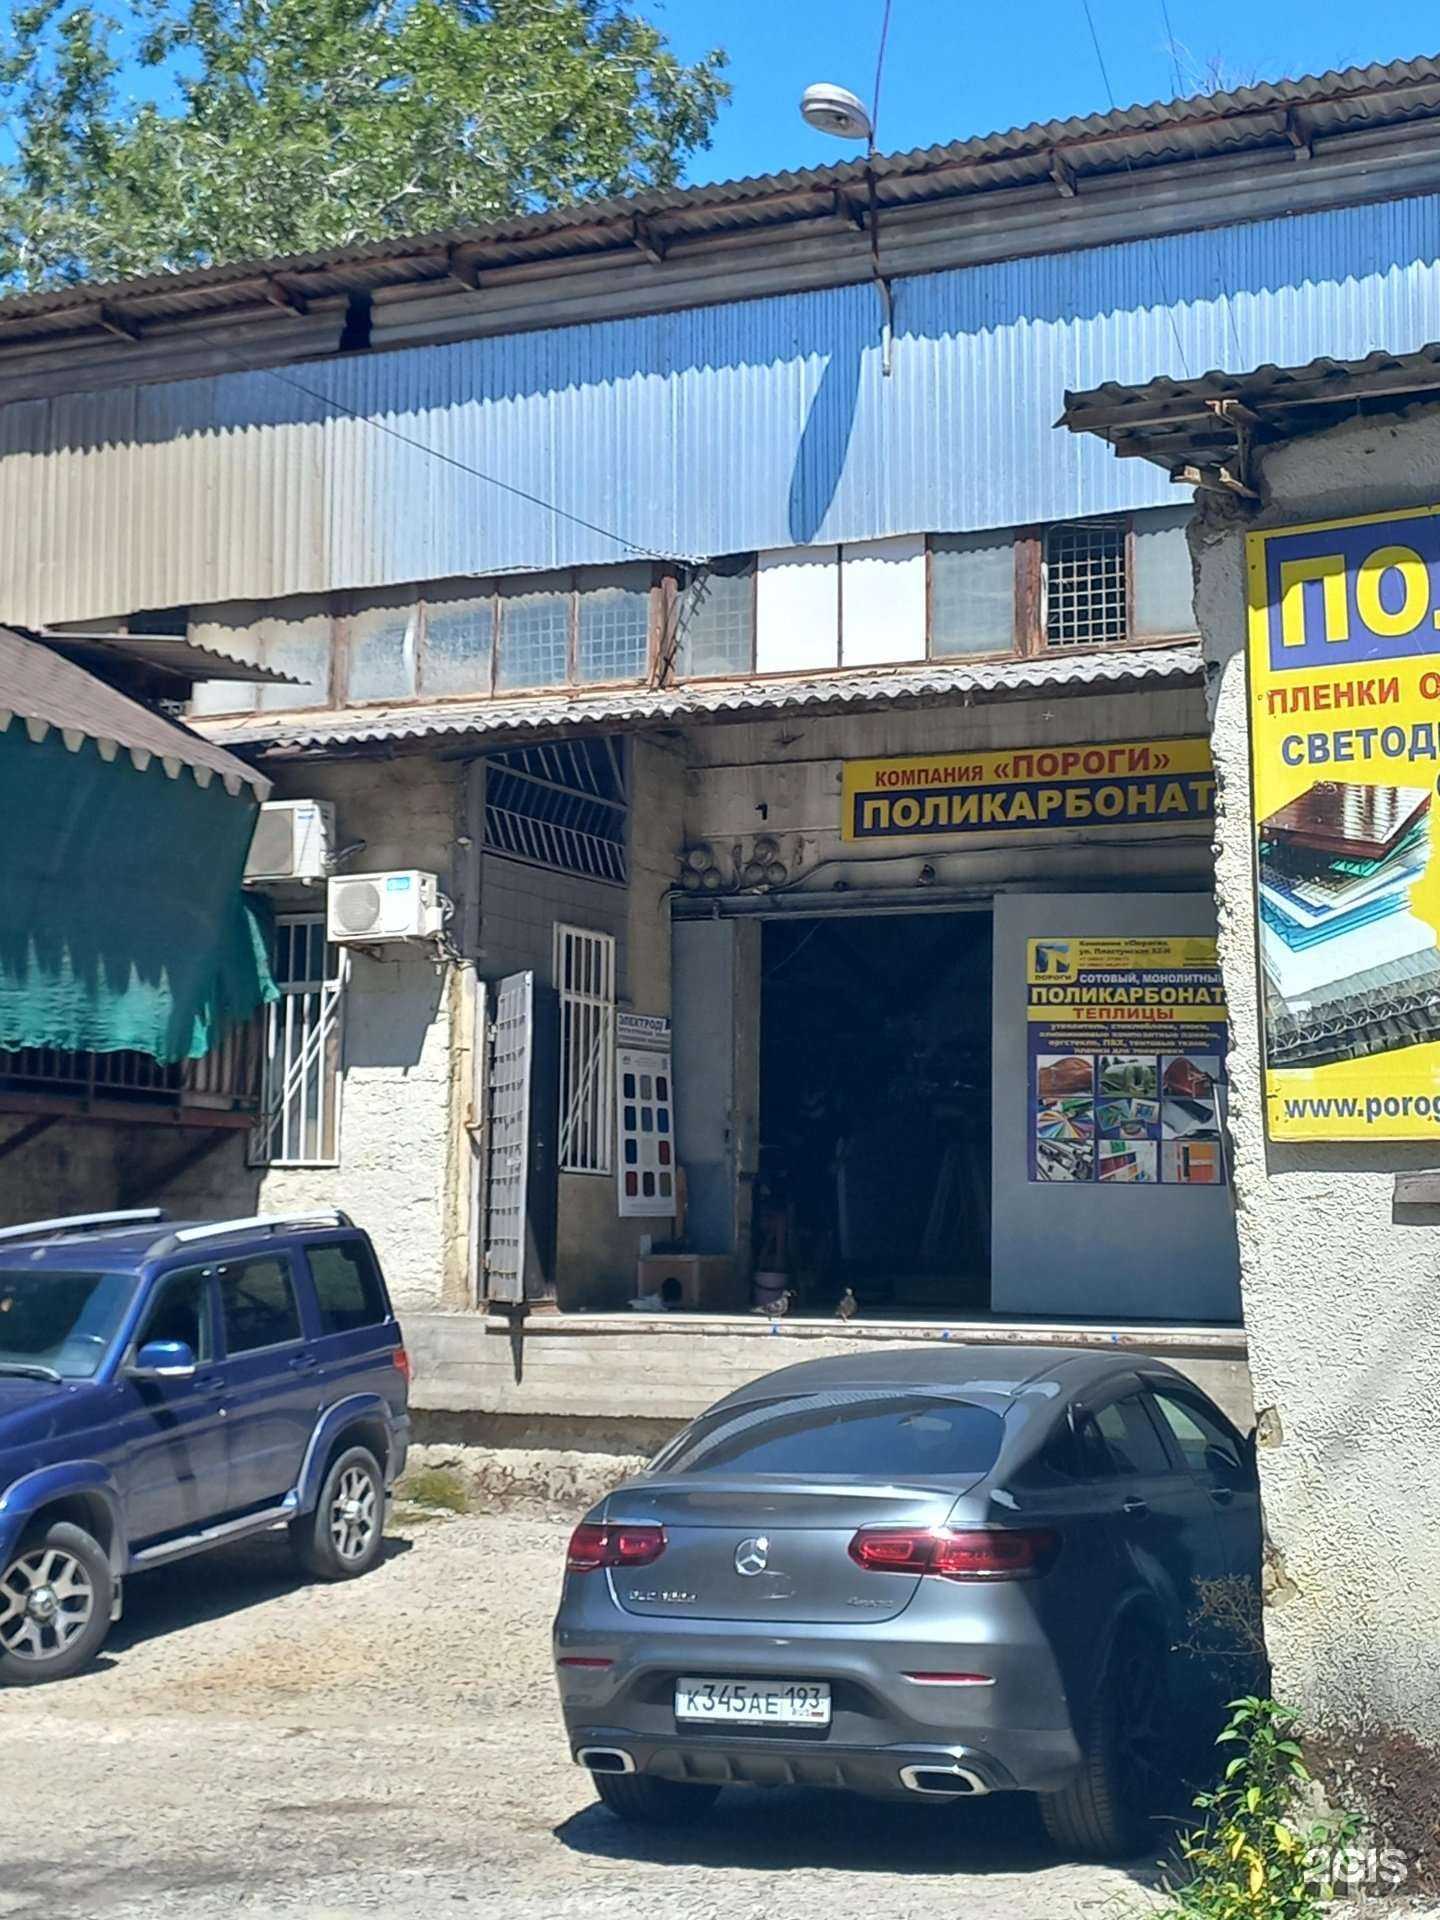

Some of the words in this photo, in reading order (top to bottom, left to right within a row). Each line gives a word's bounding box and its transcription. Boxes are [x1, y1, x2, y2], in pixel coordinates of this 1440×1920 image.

[1280, 546, 1440, 647] ПО
[1267, 677, 1399, 716] ПЛЕНКИ
[1282, 722, 1440, 766] СВЕТОД
[875, 765, 983, 787] КОМПАНИЯ
[994, 748, 1171, 779] «ПОРОГИ»
[863, 782, 1216, 829] ПОЛИКАРБОНАТ
[1031, 986, 1225, 1005] ПОЛИКАРБОНАТ
[1080, 973, 1140, 985] СОТОВЫЙ,
[1072, 1007, 1174, 1021] ТЕПЛИЦЫ
[785, 1687, 820, 1709] 193
